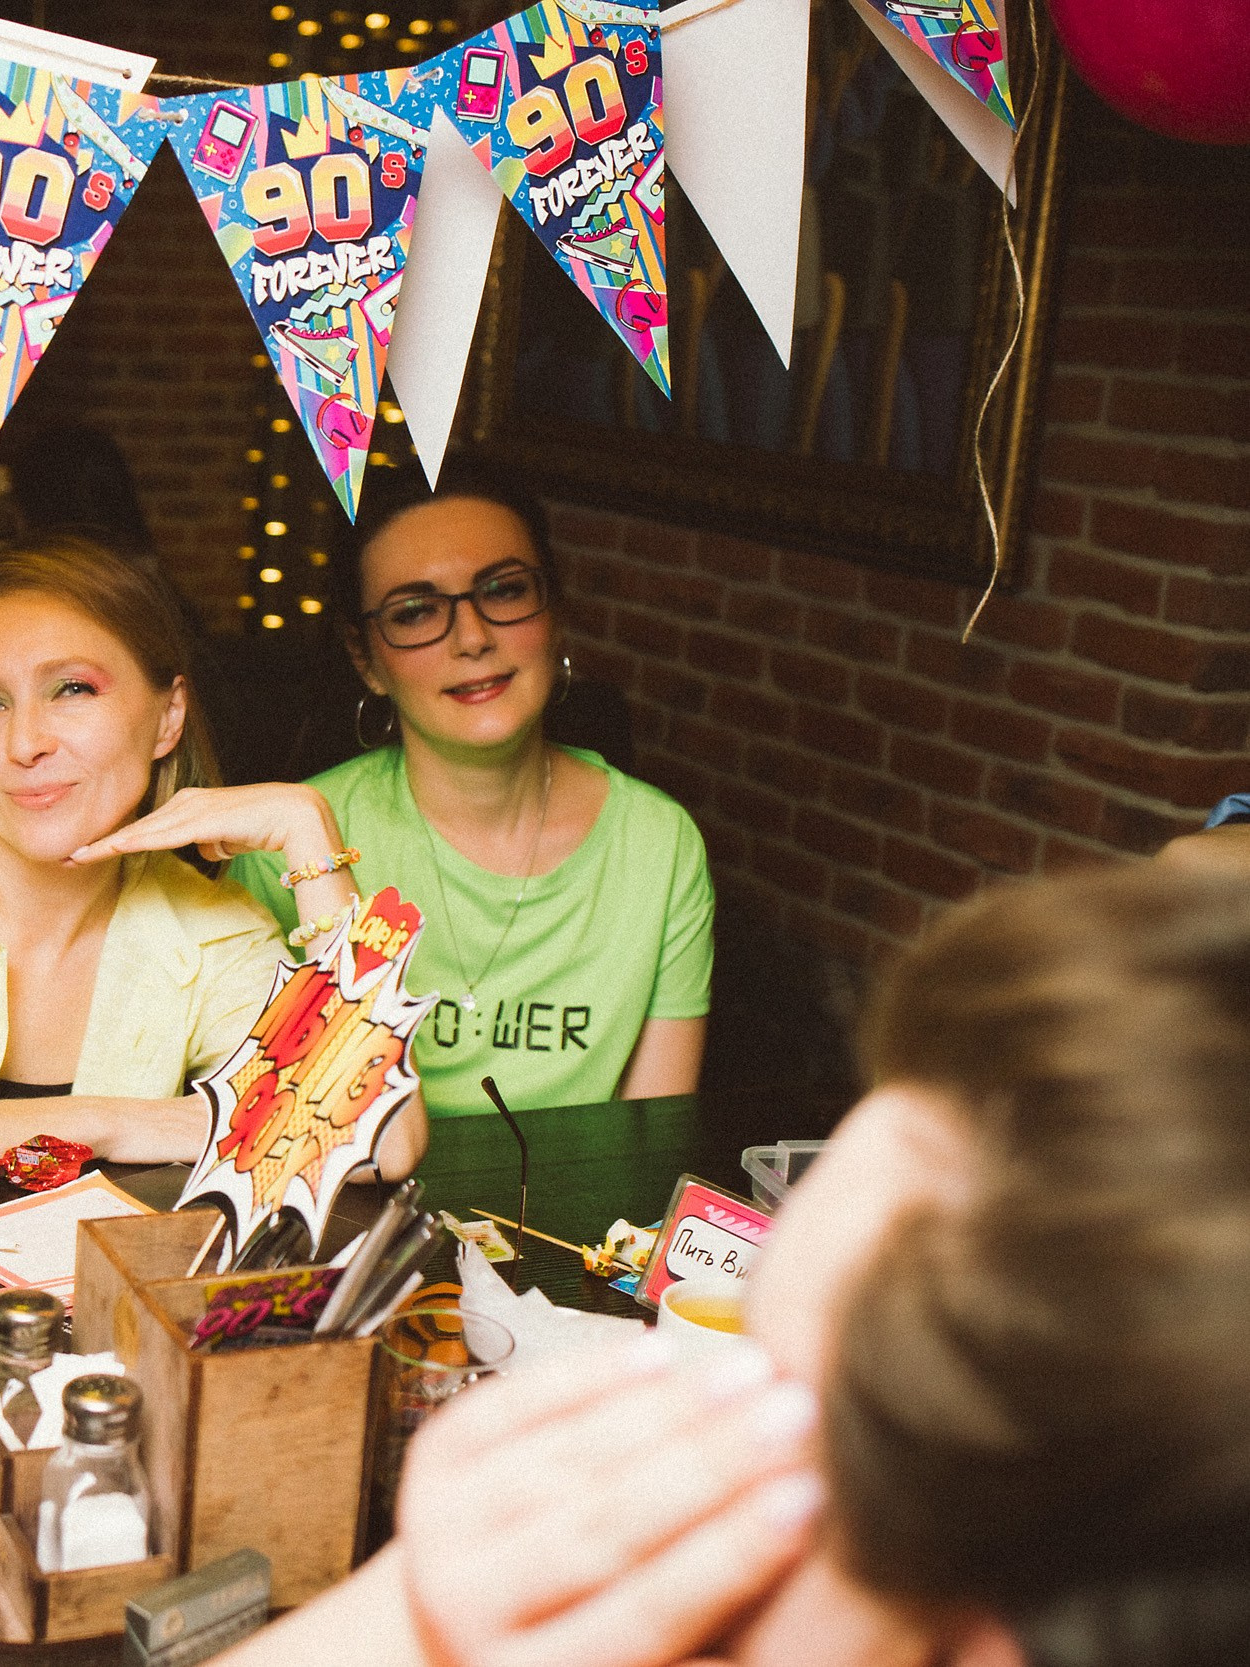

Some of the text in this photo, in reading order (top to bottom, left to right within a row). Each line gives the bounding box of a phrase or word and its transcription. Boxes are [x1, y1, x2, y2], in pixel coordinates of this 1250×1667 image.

[529, 122, 656, 225] FOREVER
[251, 236, 396, 306] FOREVER
[434, 999, 591, 1052] O:WER
[672, 1228, 748, 1280] Пить Ви
